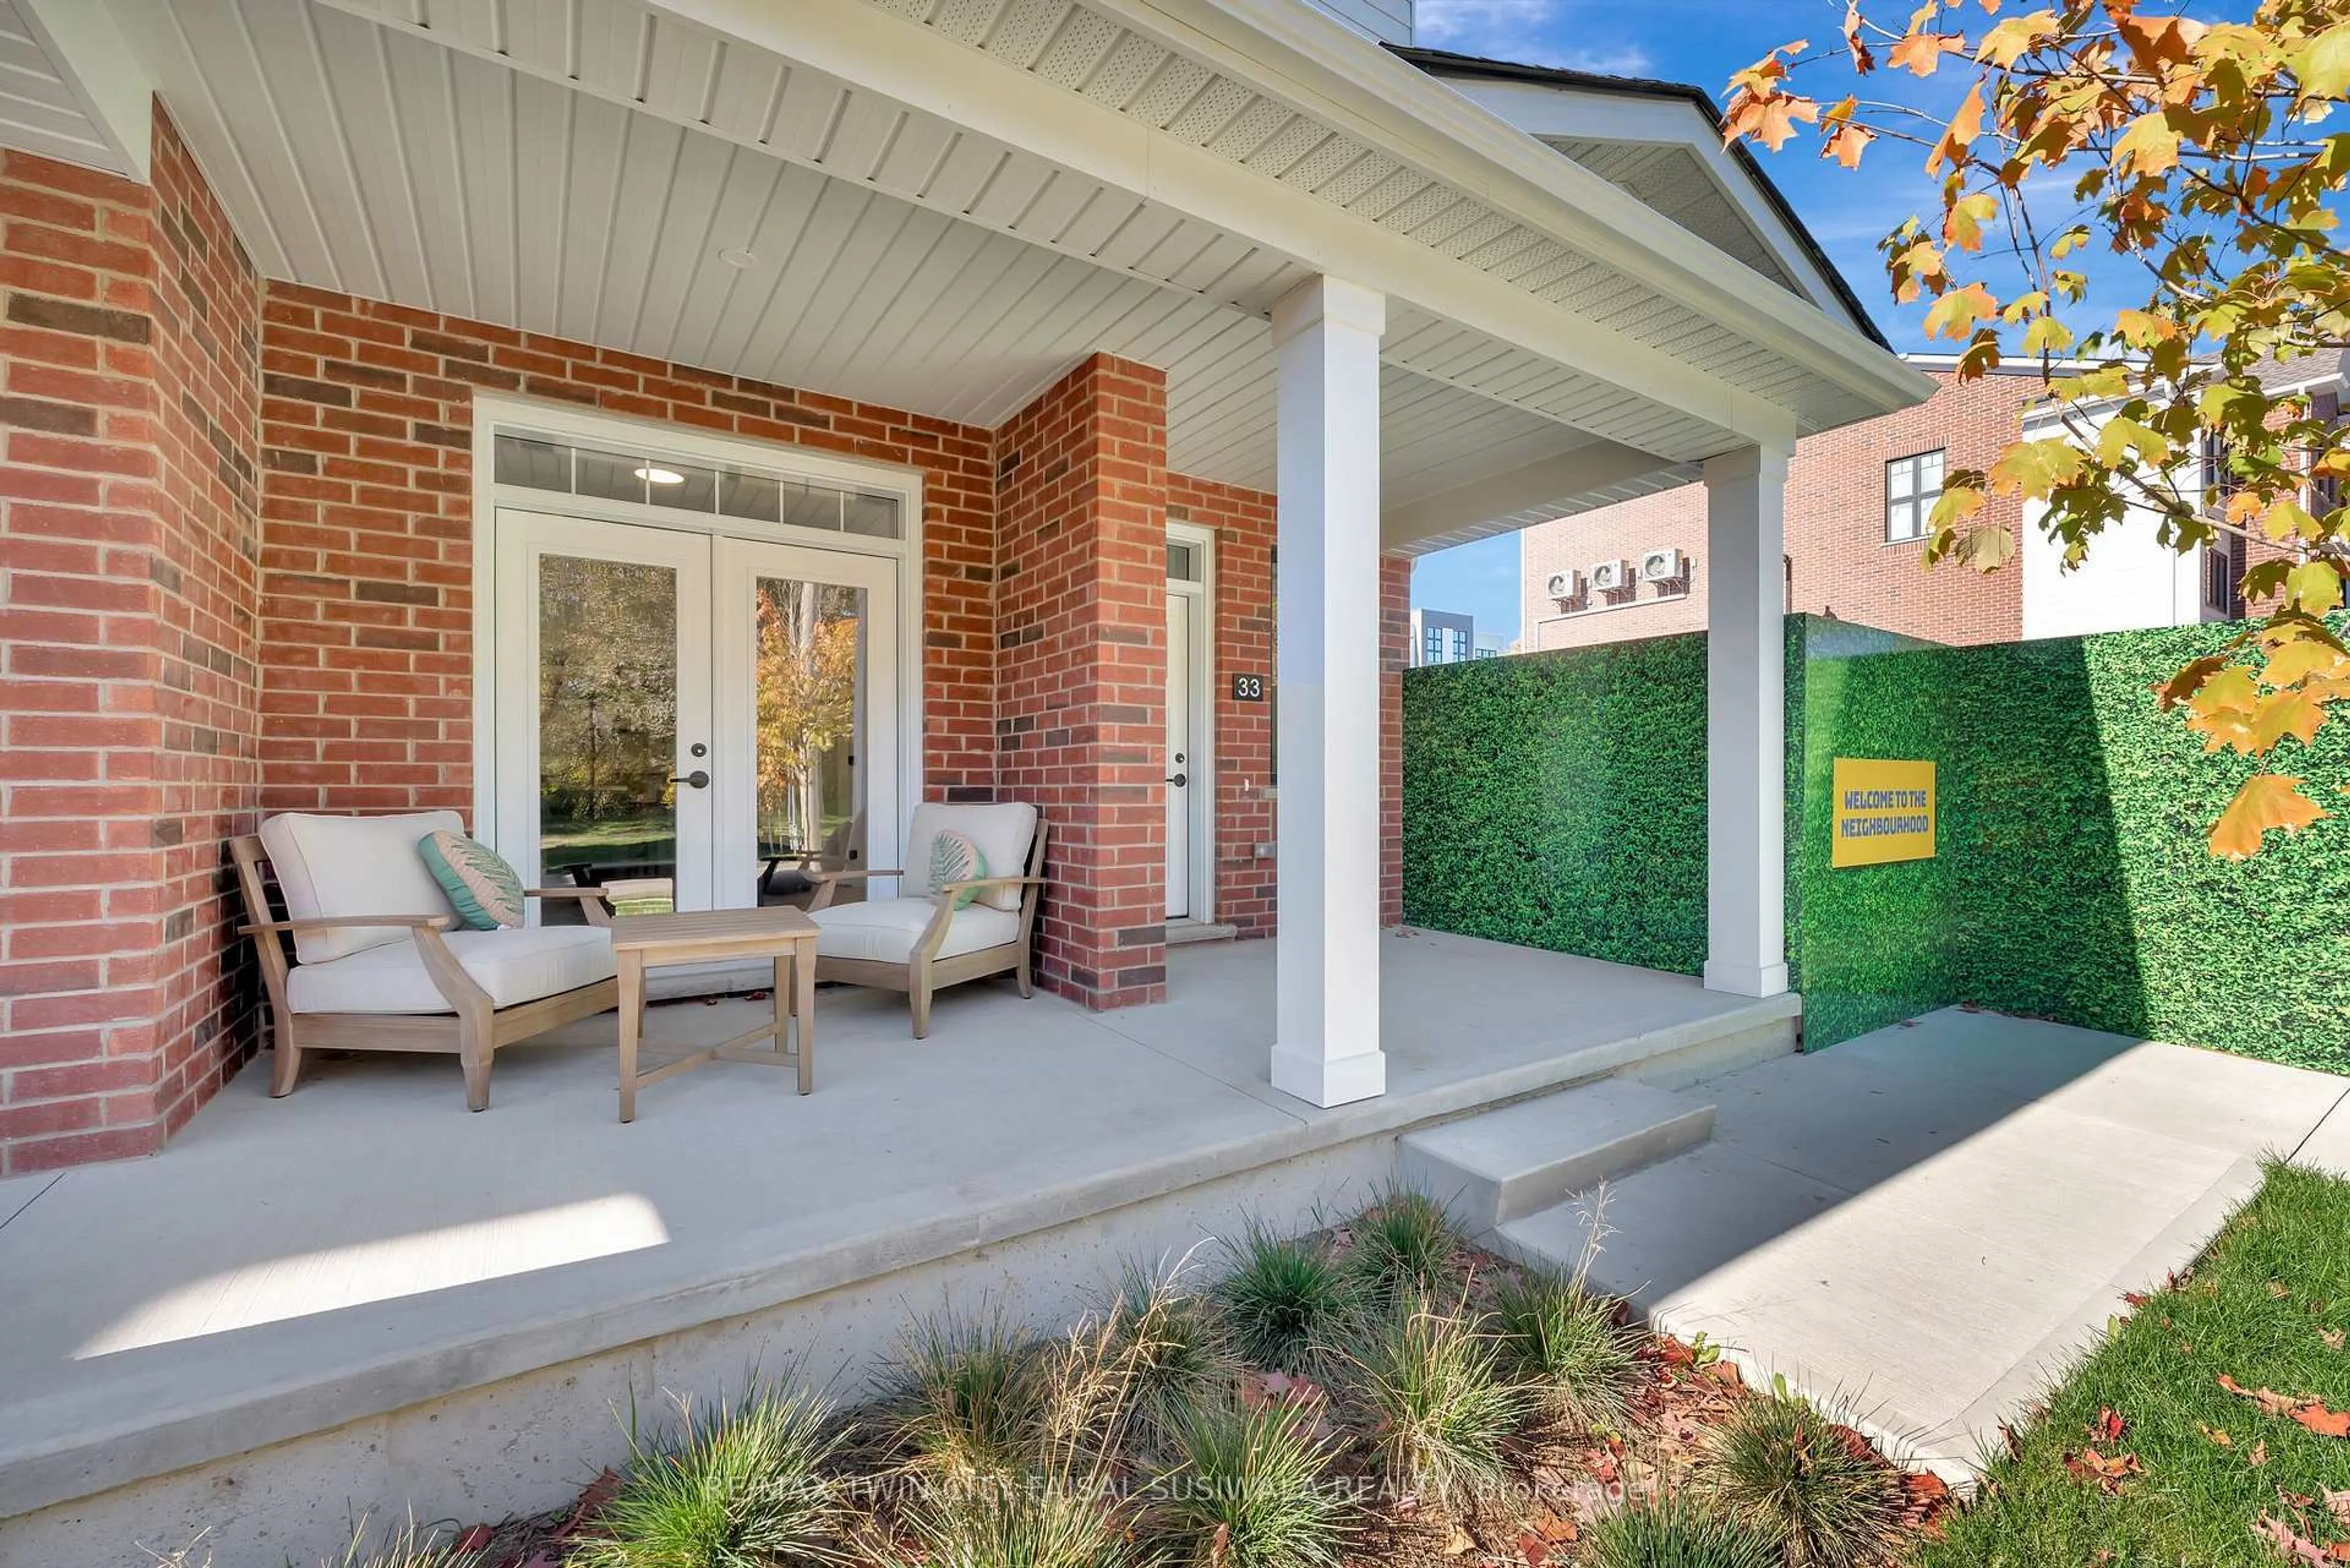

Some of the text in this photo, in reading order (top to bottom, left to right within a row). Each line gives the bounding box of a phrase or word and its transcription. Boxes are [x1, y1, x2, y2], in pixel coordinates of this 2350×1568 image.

[1238, 678, 1260, 697] 33
[1845, 790, 1926, 809] WELCOME TO THE
[1841, 816, 1928, 837] NEIGHBOURHOOD
